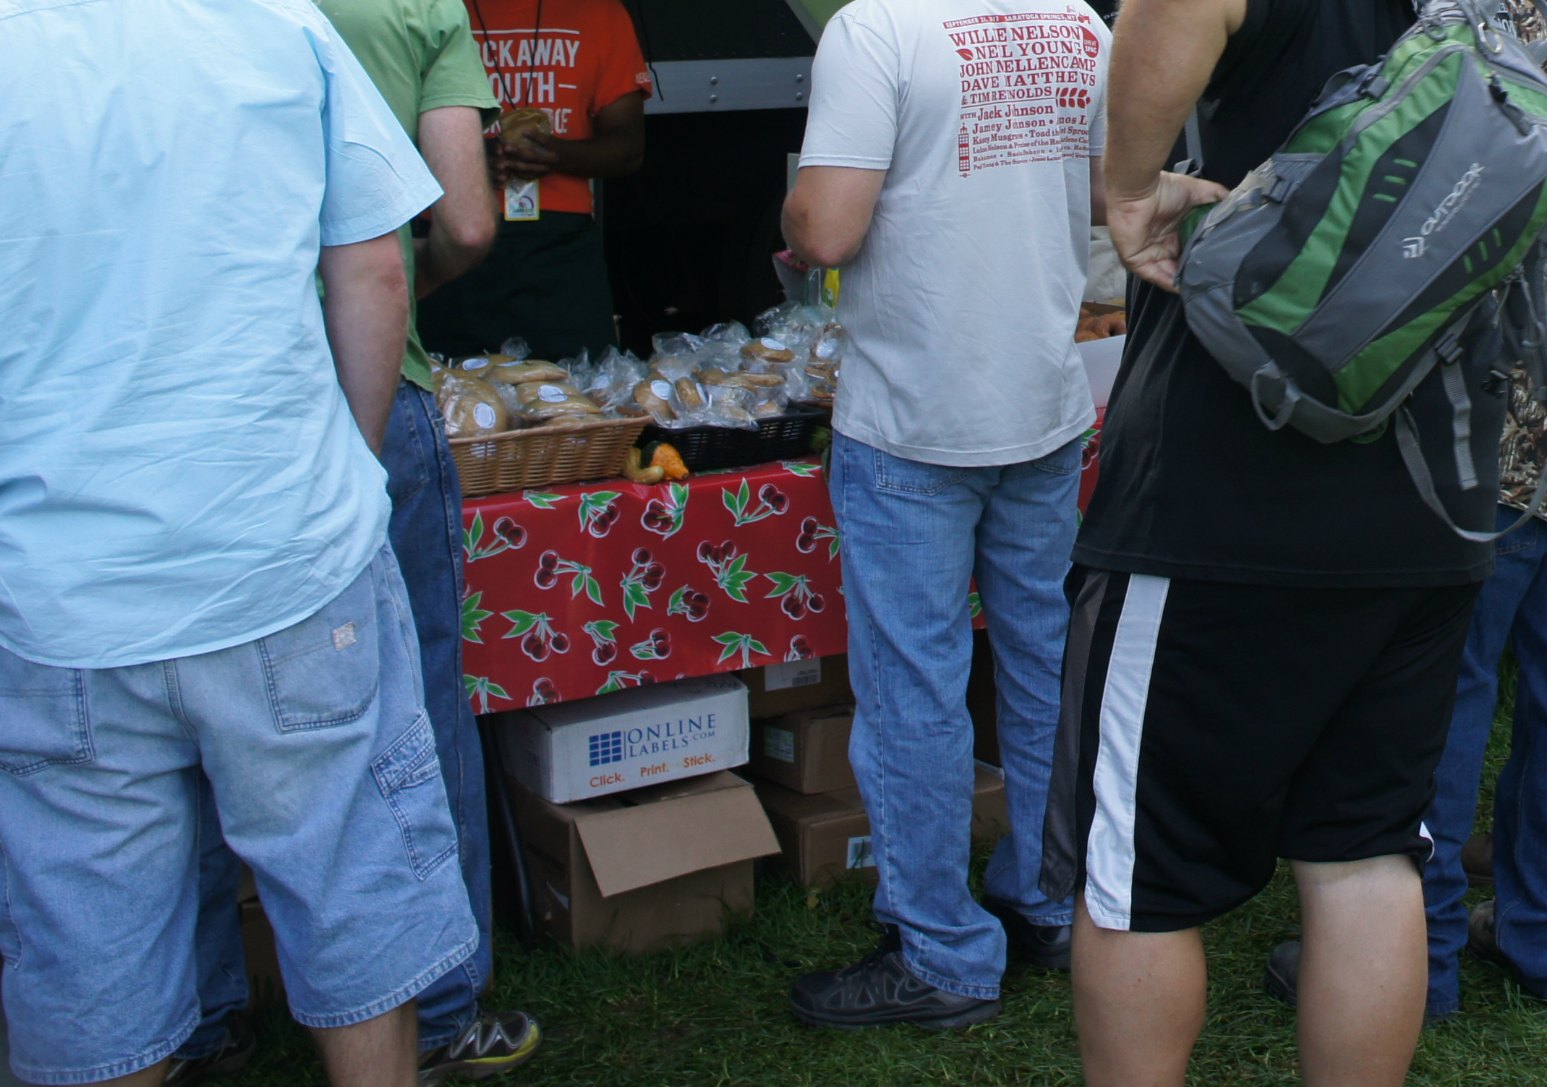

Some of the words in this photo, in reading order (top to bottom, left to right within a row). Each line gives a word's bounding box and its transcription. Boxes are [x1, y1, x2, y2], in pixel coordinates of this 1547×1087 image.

[945, 16, 980, 29] SEPTEMBER
[1004, 13, 1040, 22] SARATOGA
[948, 27, 1008, 47] WILLE
[1011, 25, 1081, 42] NELSON
[481, 38, 580, 68] CKAWAY
[975, 44, 1013, 60] NEL
[1017, 40, 1083, 57] YOUNG
[959, 61, 993, 79] JOHN
[486, 72, 556, 104] OUTH
[961, 76, 1000, 93] DAVE
[991, 86, 1053, 102] RENOLDS
[977, 105, 1003, 122] Jack
[1005, 103, 1055, 118] Jhnson
[972, 122, 1003, 135] Jamey
[627, 713, 718, 745] ONLINE
[589, 772, 626, 788] Click.
[640, 762, 669, 778] Print.
[683, 753, 717, 769] Stick.
